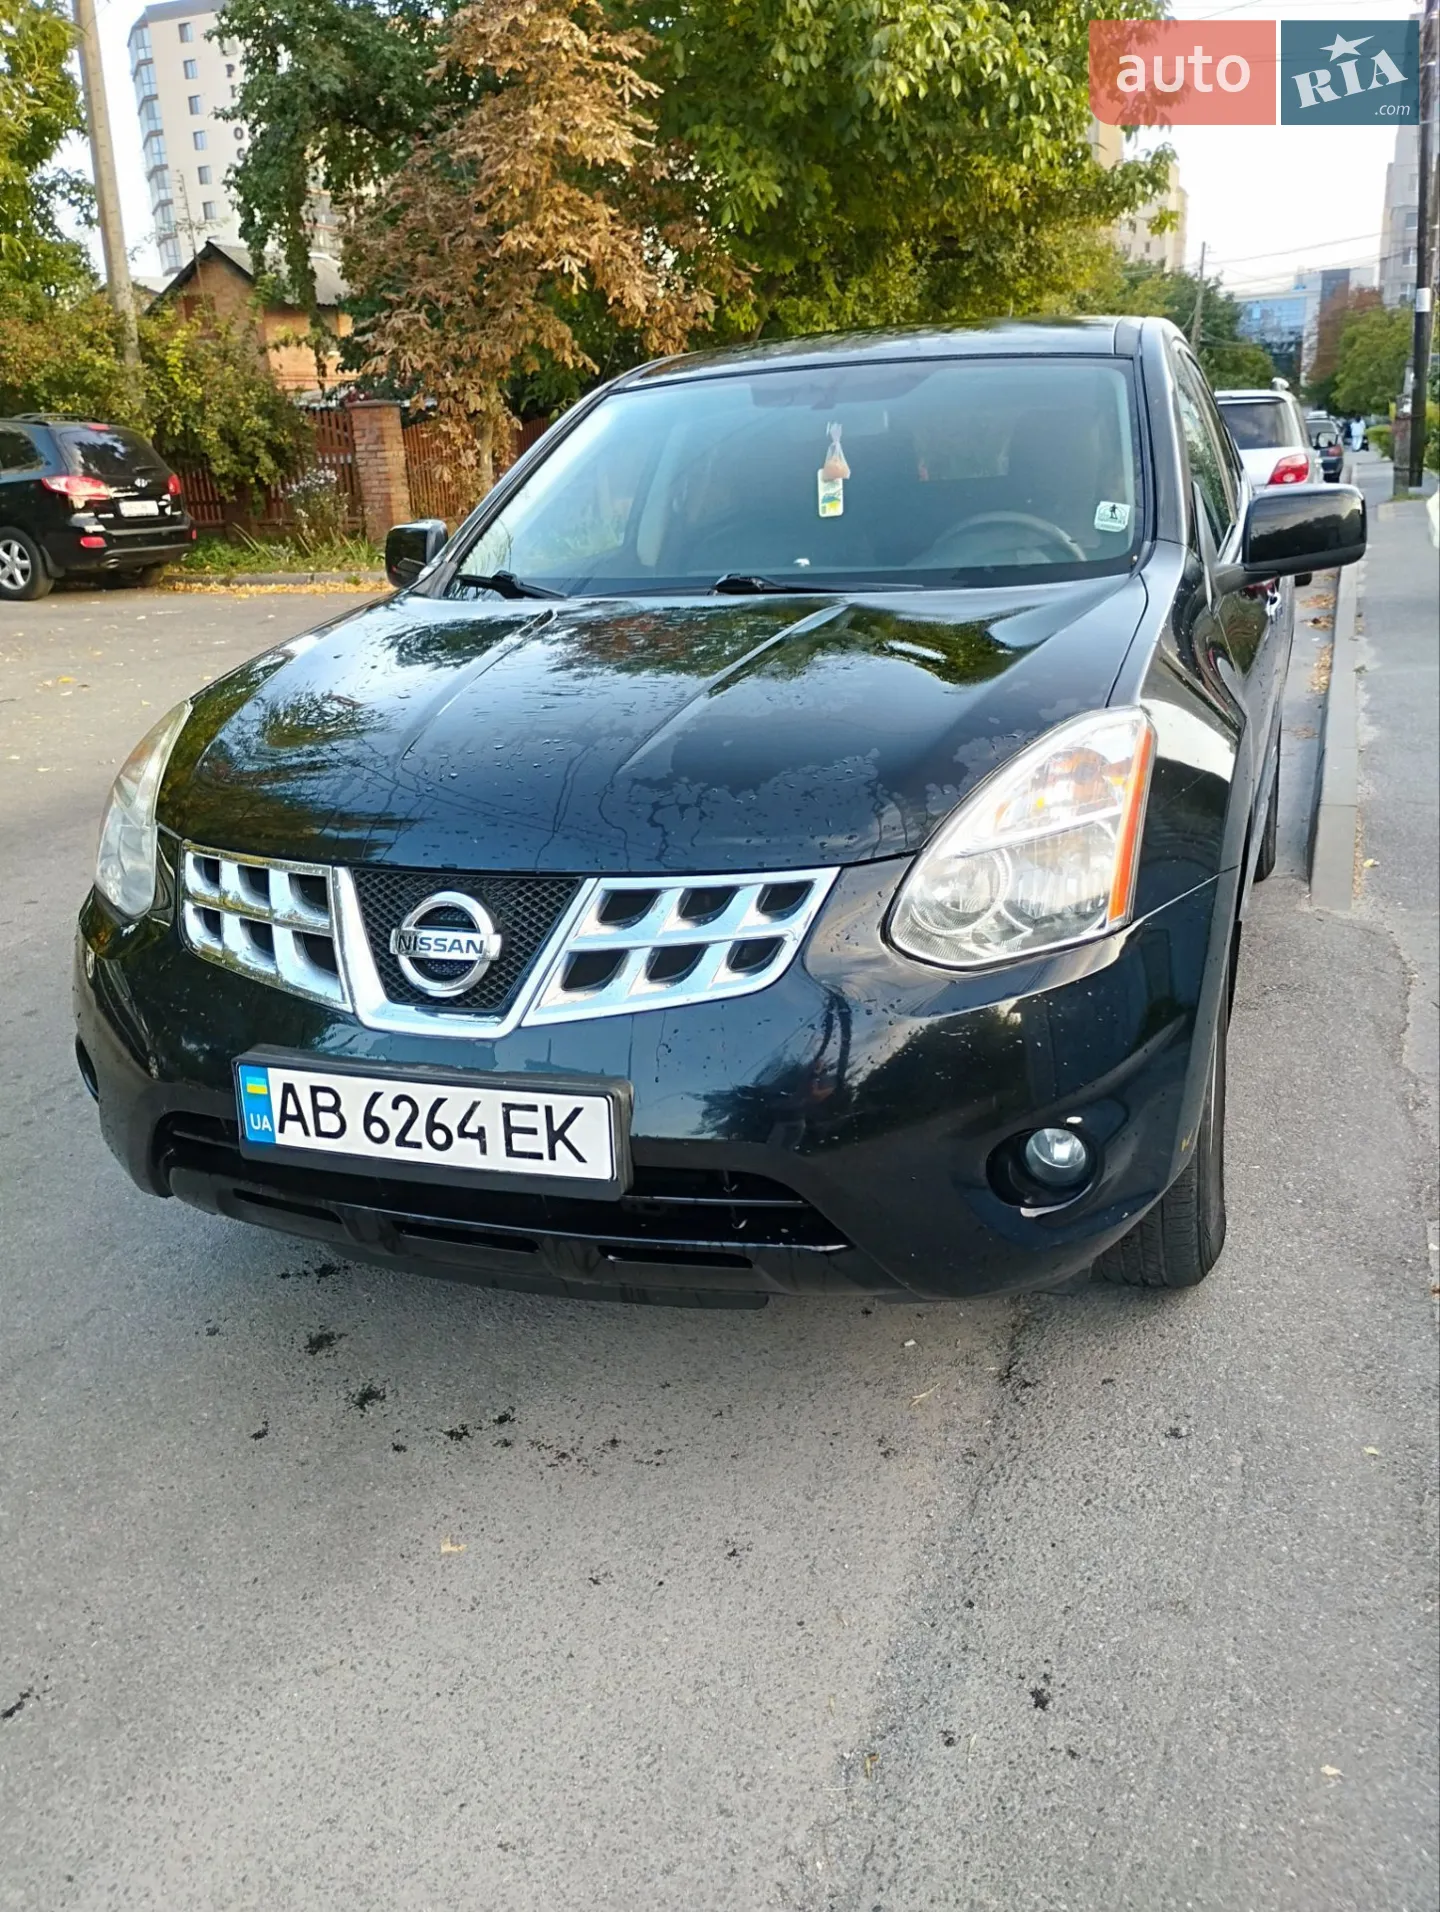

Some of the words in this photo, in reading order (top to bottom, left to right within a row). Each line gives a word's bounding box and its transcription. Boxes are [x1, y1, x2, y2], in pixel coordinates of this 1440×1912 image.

[398, 935, 485, 954] NISSAN
[250, 1113, 272, 1132] UA
[278, 1082, 347, 1139] AB
[363, 1091, 488, 1156] 6264
[501, 1102, 587, 1164] EK
